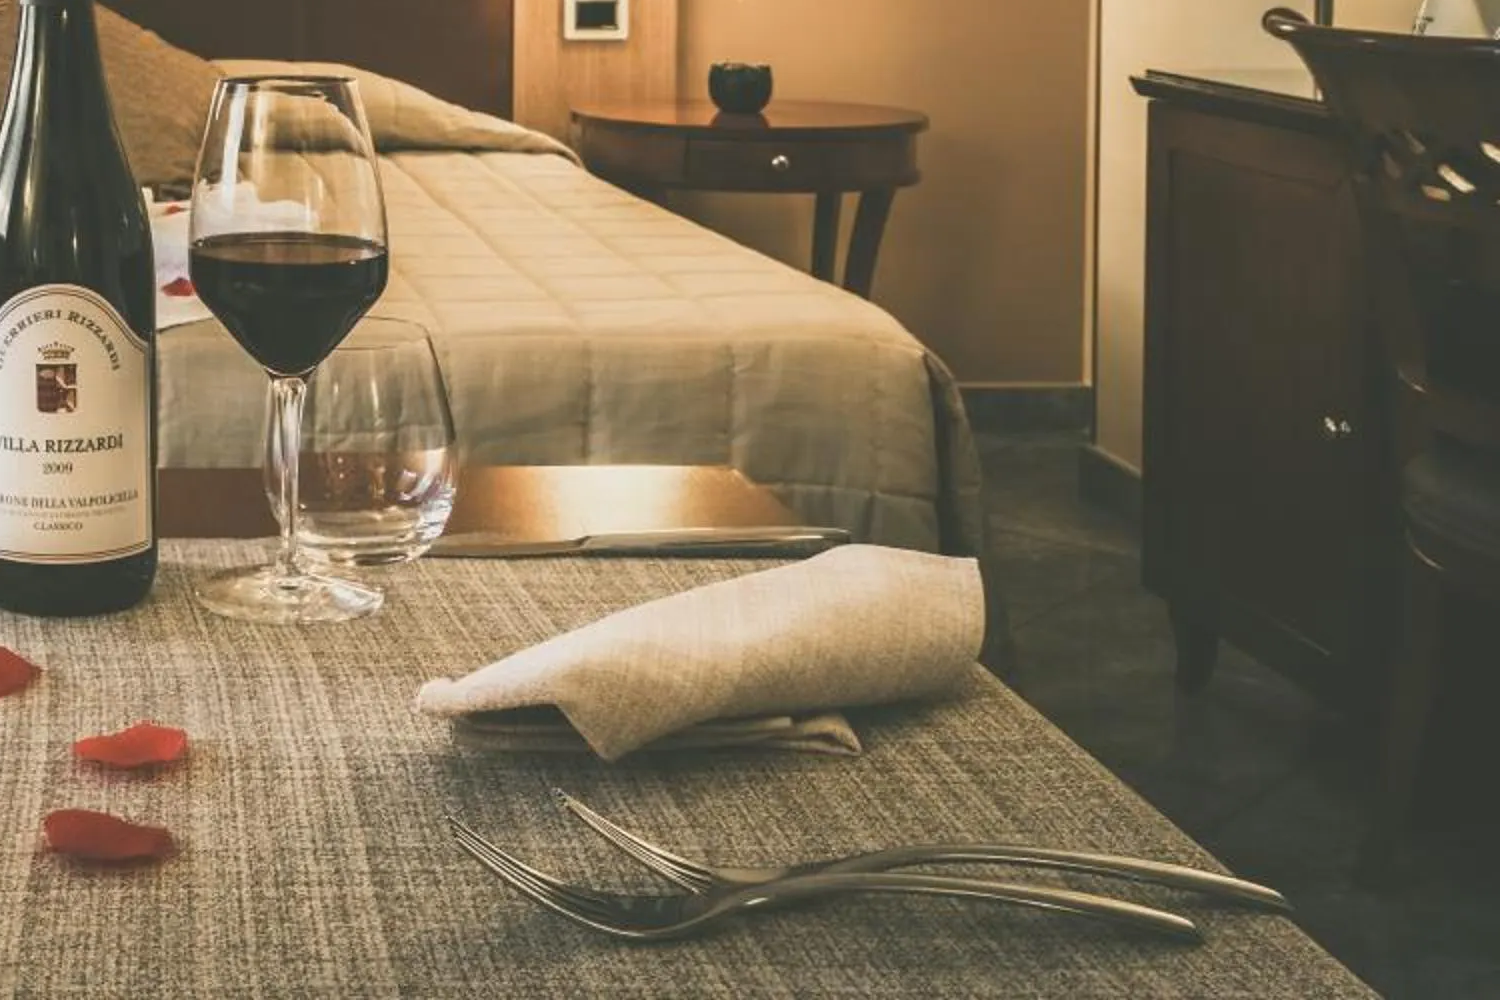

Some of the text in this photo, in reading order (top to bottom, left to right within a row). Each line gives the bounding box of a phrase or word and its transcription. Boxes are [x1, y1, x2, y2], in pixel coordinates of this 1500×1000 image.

[67, 309, 121, 372] RIZZARDI
[45, 433, 124, 454] RIZZARDI
[41, 462, 74, 475] 2009
[31, 495, 68, 510] DELLA
[32, 520, 84, 532] CLASSICO
